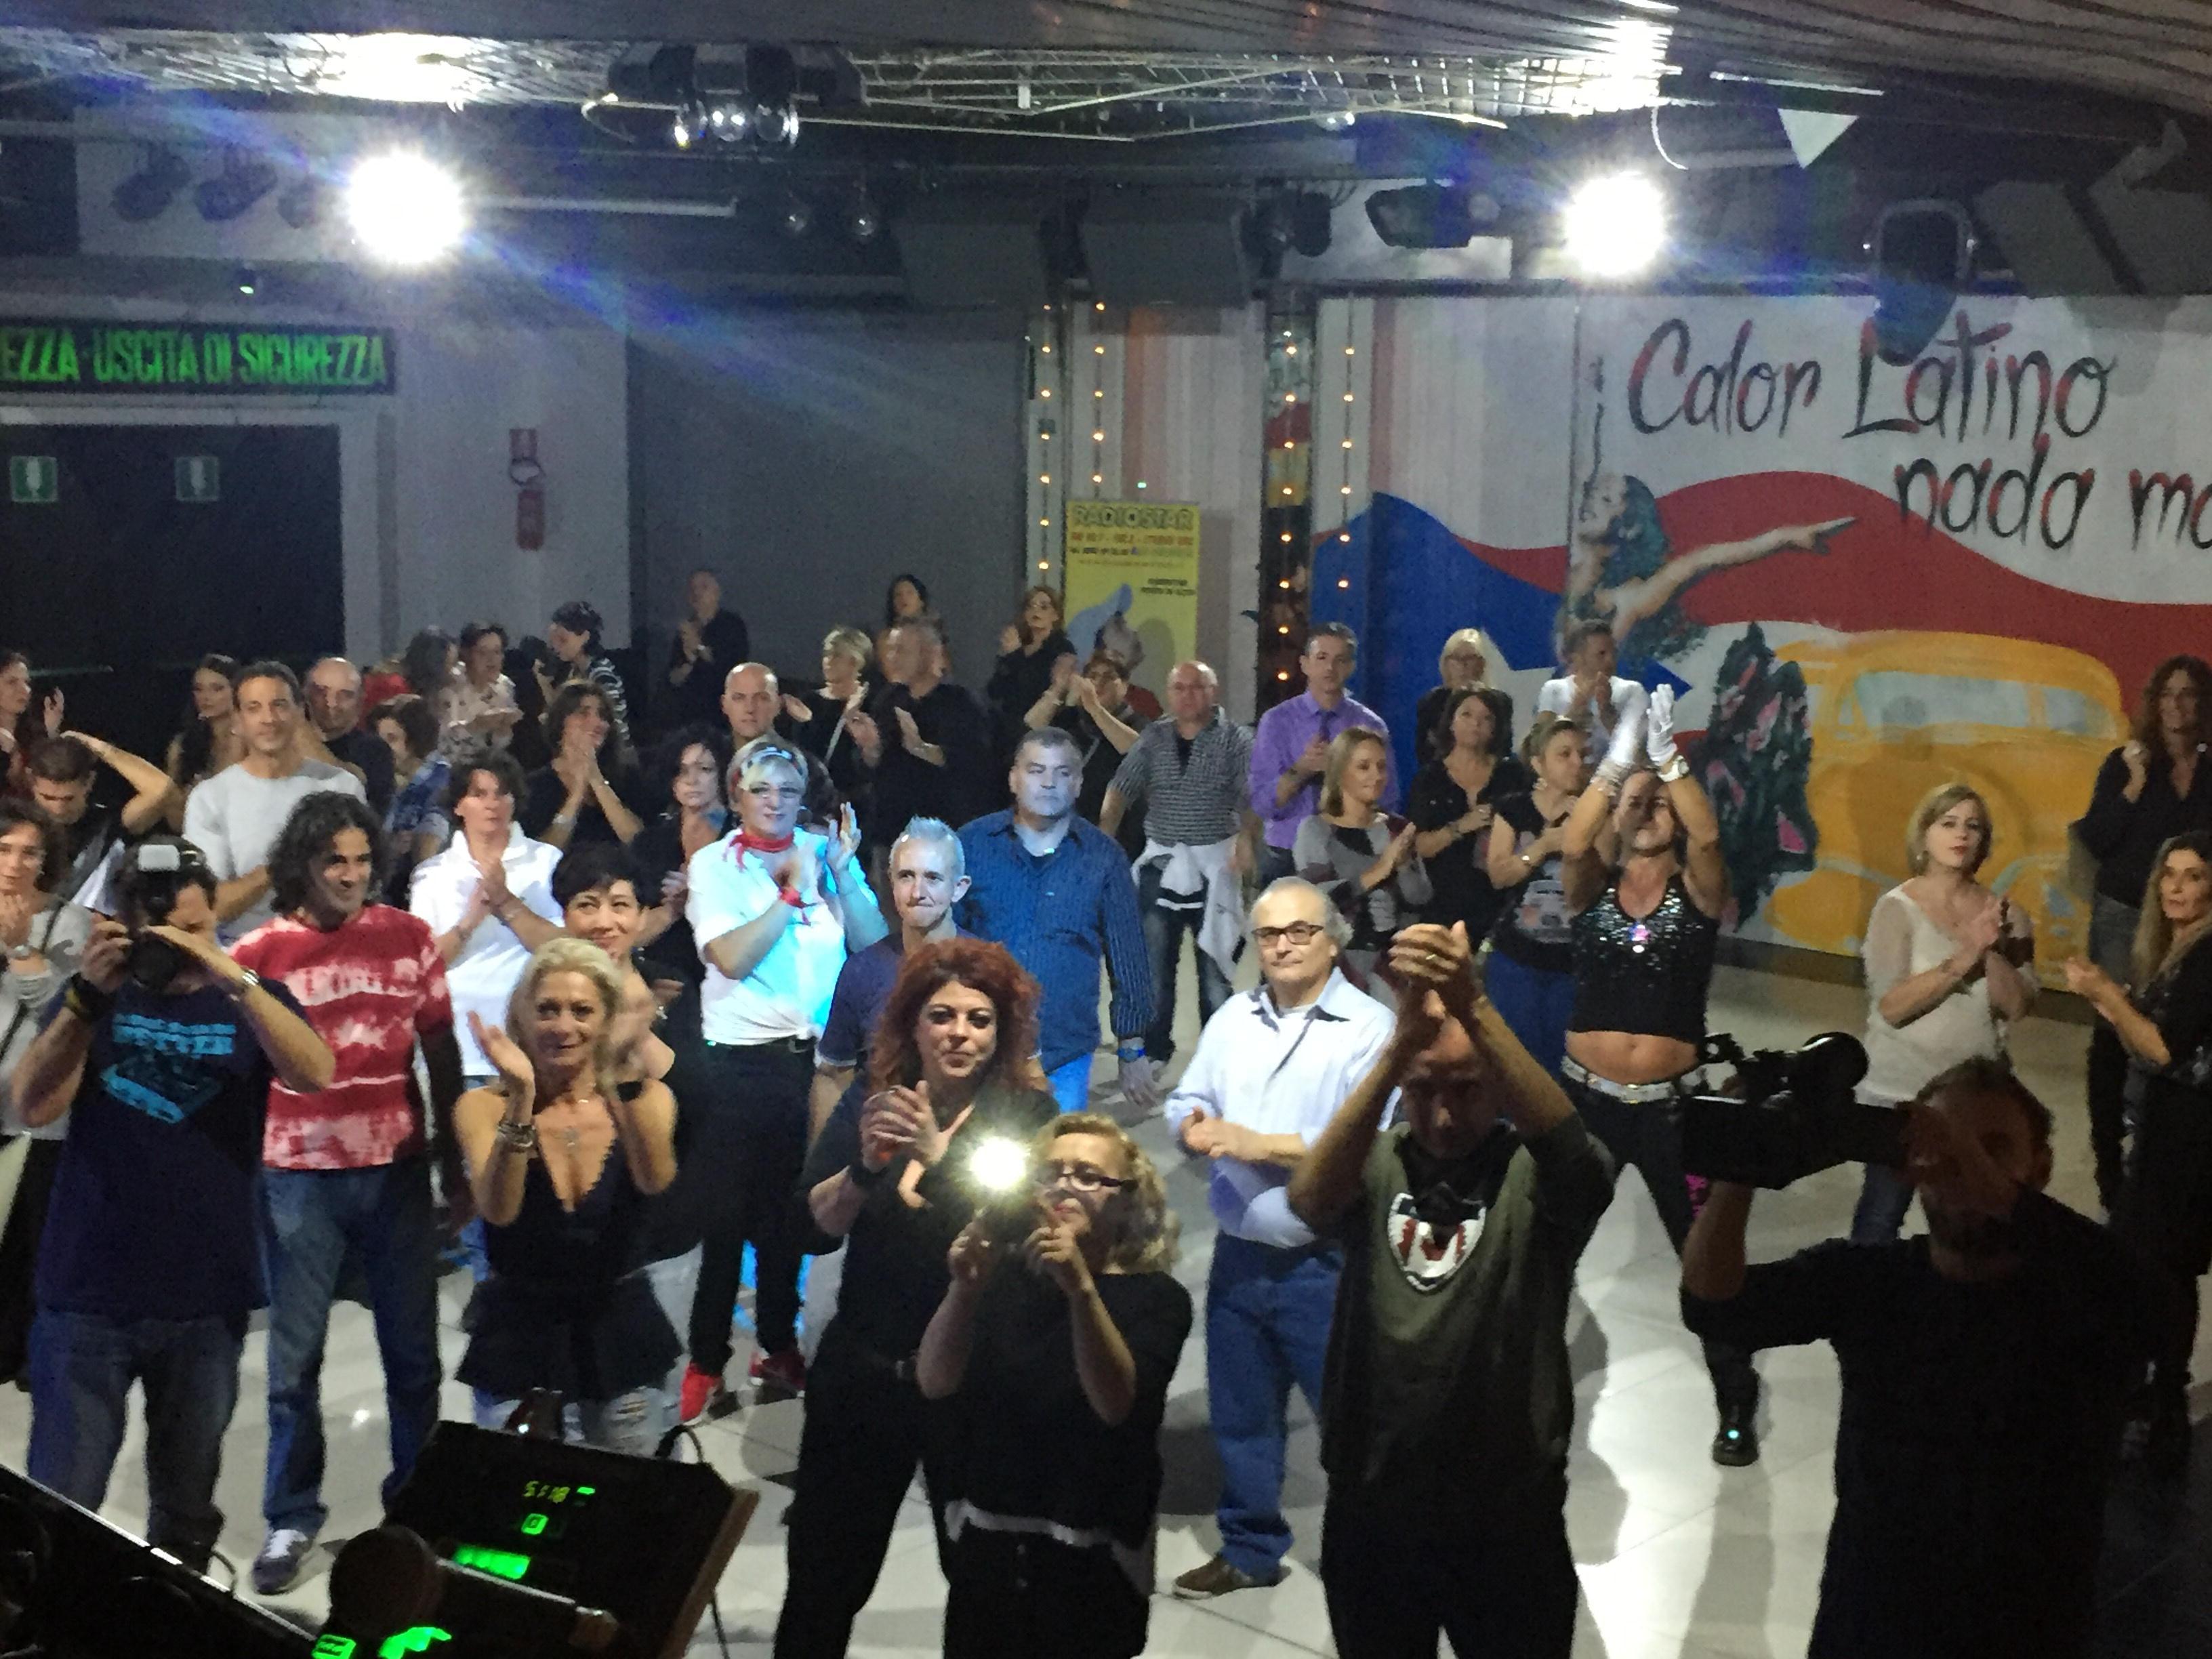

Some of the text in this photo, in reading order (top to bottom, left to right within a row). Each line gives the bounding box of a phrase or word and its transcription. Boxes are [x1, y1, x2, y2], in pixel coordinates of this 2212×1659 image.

[237, 333, 387, 386] SICUREZZA
[1841, 309, 2118, 450] Latino
[1894, 432, 2095, 550] nada
